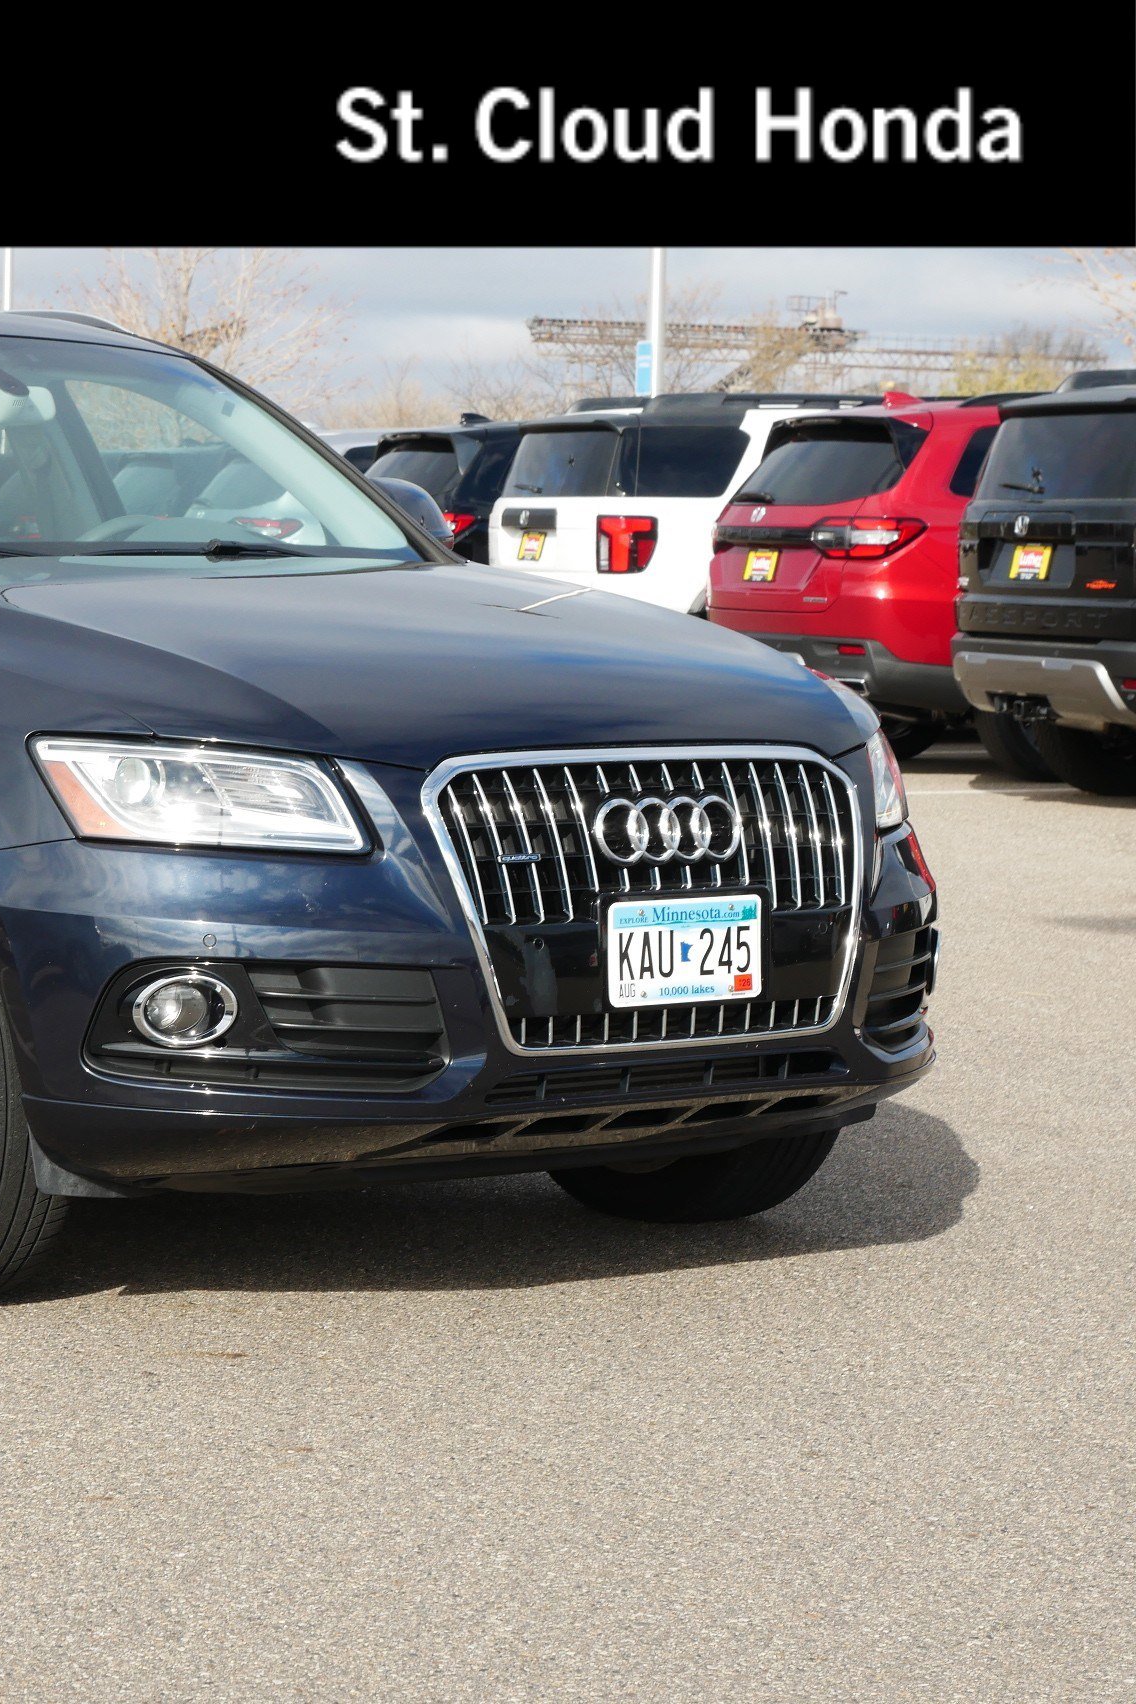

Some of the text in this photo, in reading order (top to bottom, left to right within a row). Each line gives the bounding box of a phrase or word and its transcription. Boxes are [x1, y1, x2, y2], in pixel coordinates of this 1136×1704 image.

[619, 916, 649, 925] EXPLORE
[619, 925, 751, 982] KAU 245
[618, 983, 636, 999] AUG
[659, 984, 715, 997] 10,000 lakes
